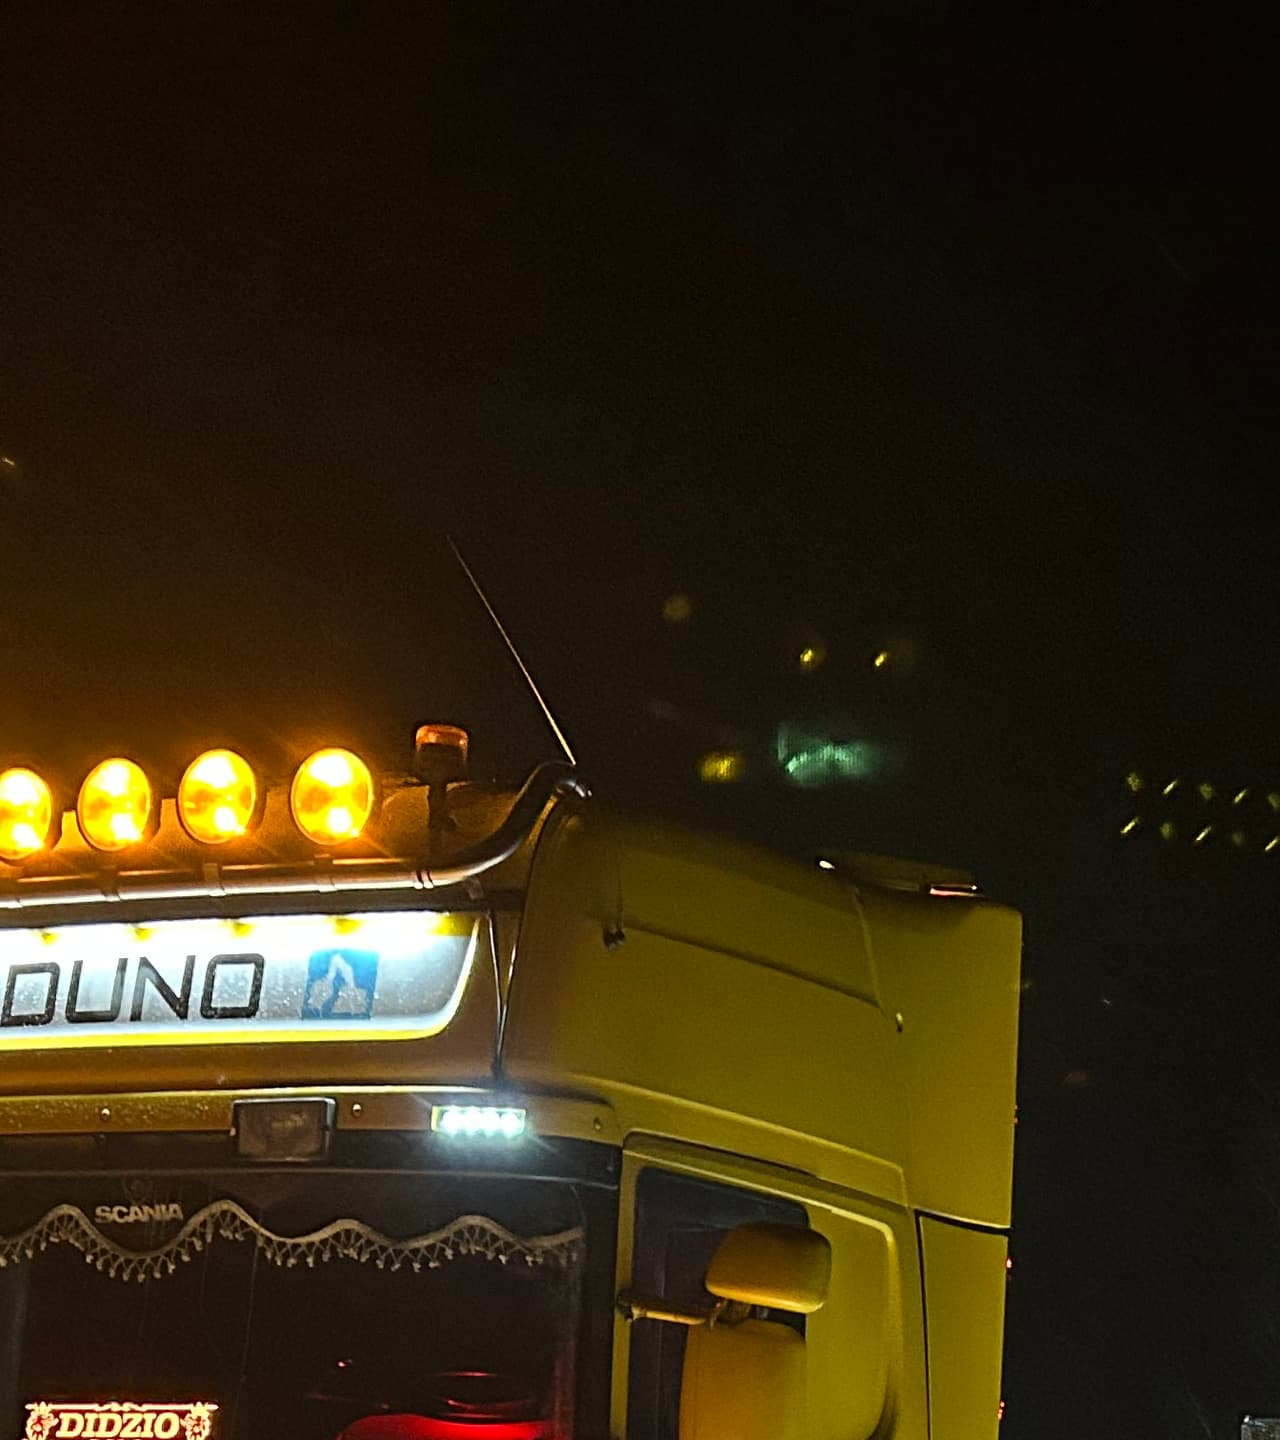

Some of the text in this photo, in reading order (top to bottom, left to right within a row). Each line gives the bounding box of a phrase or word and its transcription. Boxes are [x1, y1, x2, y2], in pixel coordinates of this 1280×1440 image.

[0, 952, 266, 1028] DUNO
[95, 1203, 183, 1223] SCANIA
[55, 1412, 180, 1439] DIDZIO
